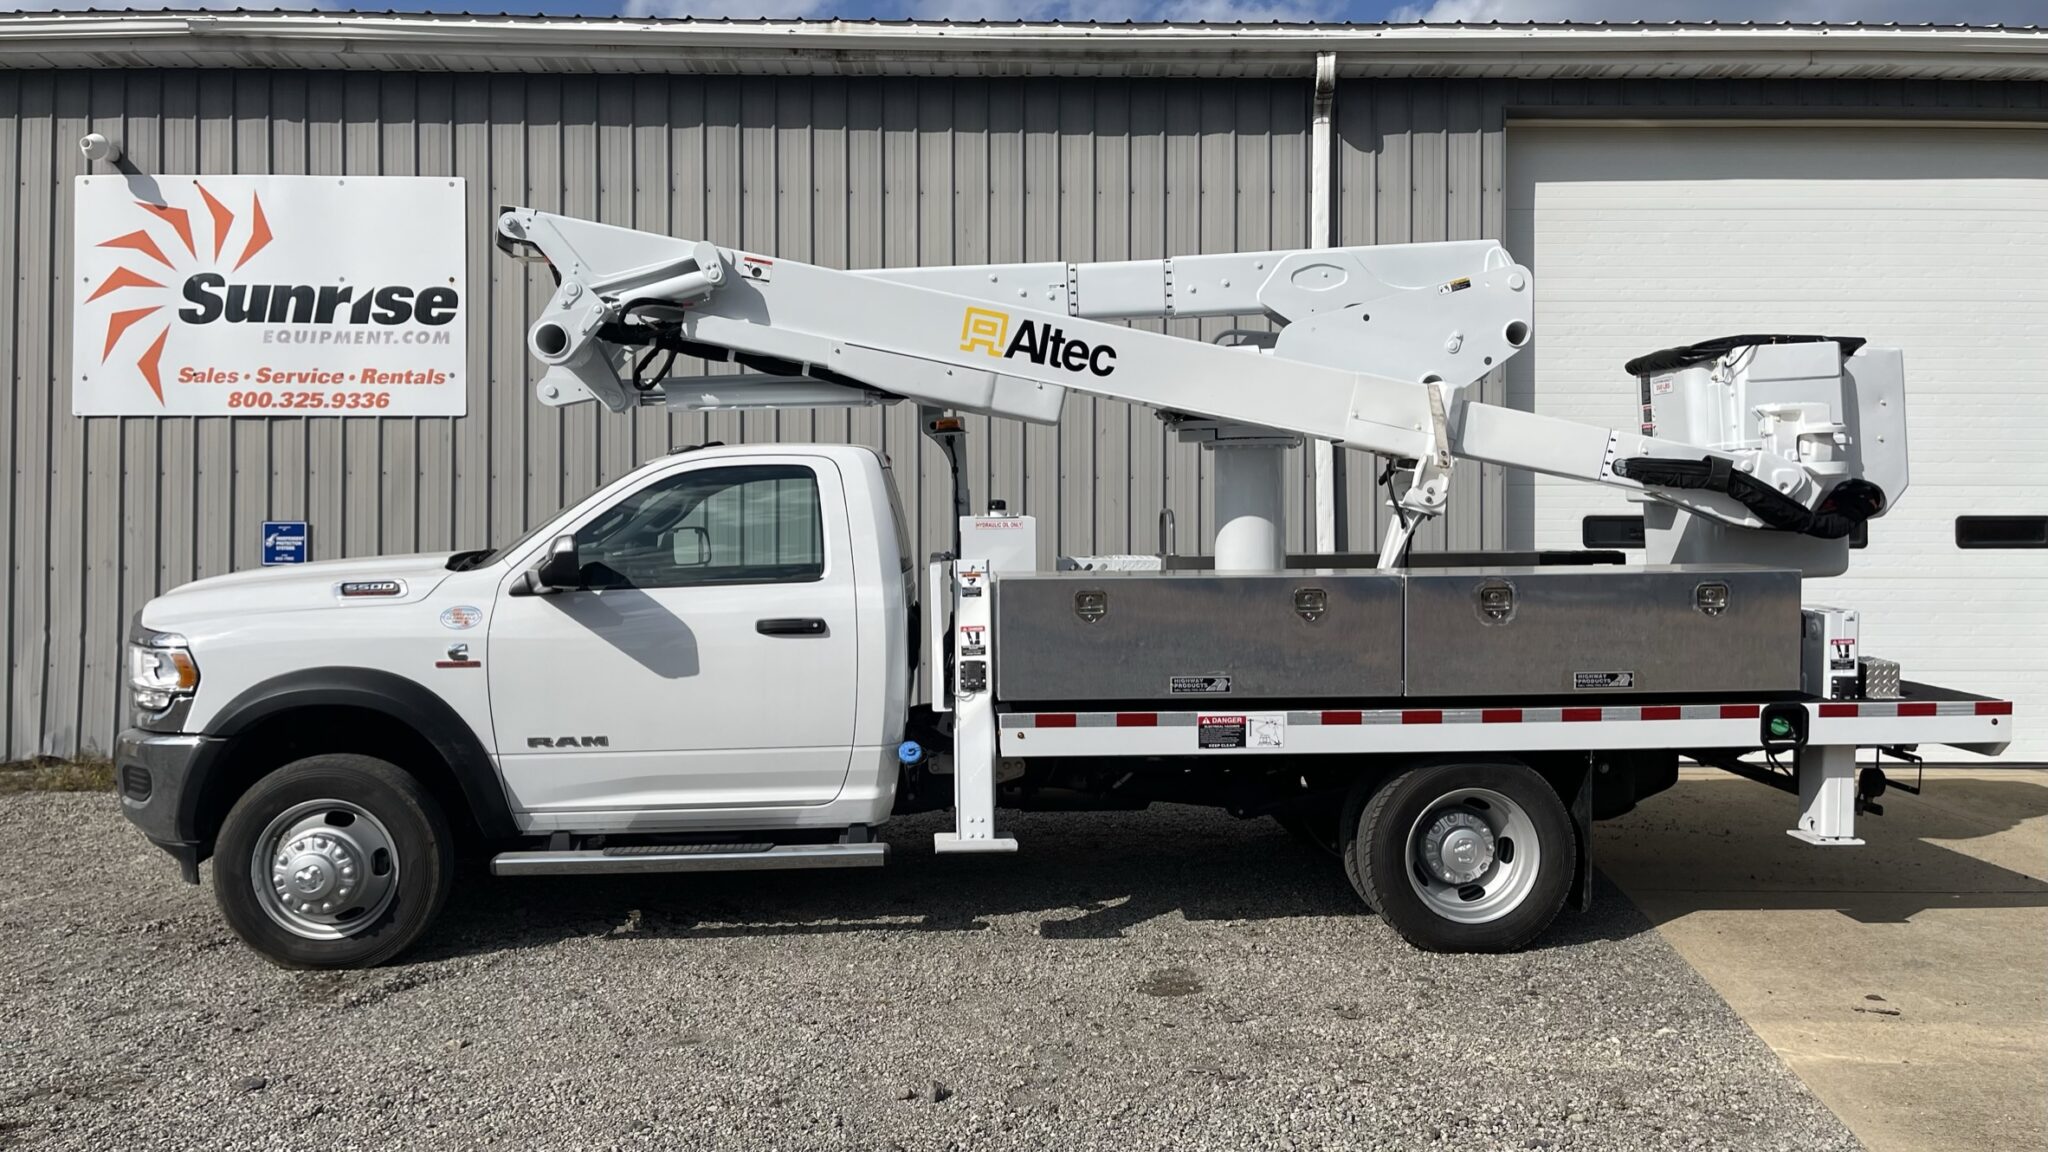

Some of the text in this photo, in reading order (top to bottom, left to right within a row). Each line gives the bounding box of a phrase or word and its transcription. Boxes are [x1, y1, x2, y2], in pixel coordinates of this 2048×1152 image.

[178, 272, 459, 326] Sunrise
[262, 329, 450, 345] EQUIPMENT.COM
[1003, 319, 1117, 377] Altec
[178, 366, 446, 385] Sales Service Rentals
[227, 391, 390, 409] 800.325.9336
[345, 582, 395, 590] 5500
[527, 735, 609, 748] RAM
